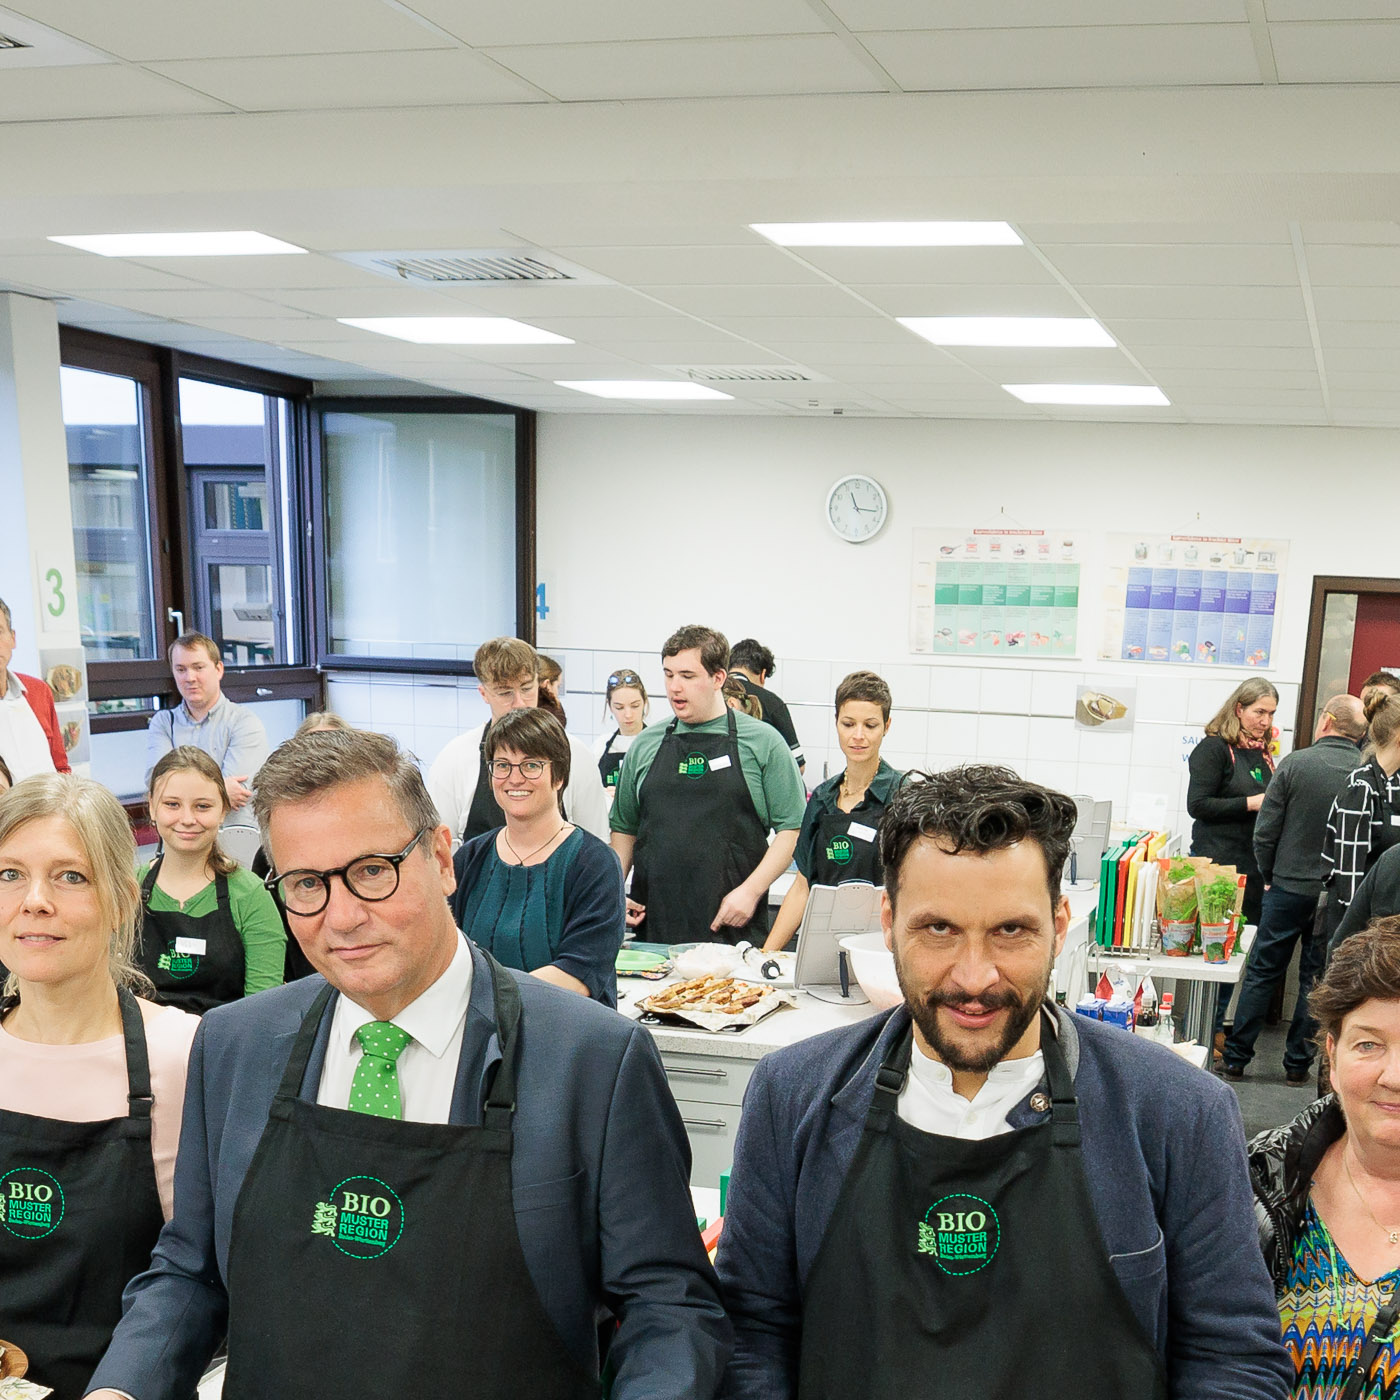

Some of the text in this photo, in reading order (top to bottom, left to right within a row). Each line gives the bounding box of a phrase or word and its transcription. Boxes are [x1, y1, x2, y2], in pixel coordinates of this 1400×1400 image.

[46, 568, 65, 616] 3
[536, 583, 549, 619] 4
[833, 841, 849, 849] BIO
[8, 1182, 53, 1202] BIO
[9, 1200, 51, 1212] MUSTER
[341, 1192, 391, 1217] BIO
[9, 1209, 51, 1222] REGION
[340, 1212, 389, 1229] MUSTER
[937, 1211, 986, 1231] BIO
[339, 1224, 388, 1240] REGION
[938, 1232, 987, 1243] MUSTER
[939, 1242, 987, 1254] REGION
